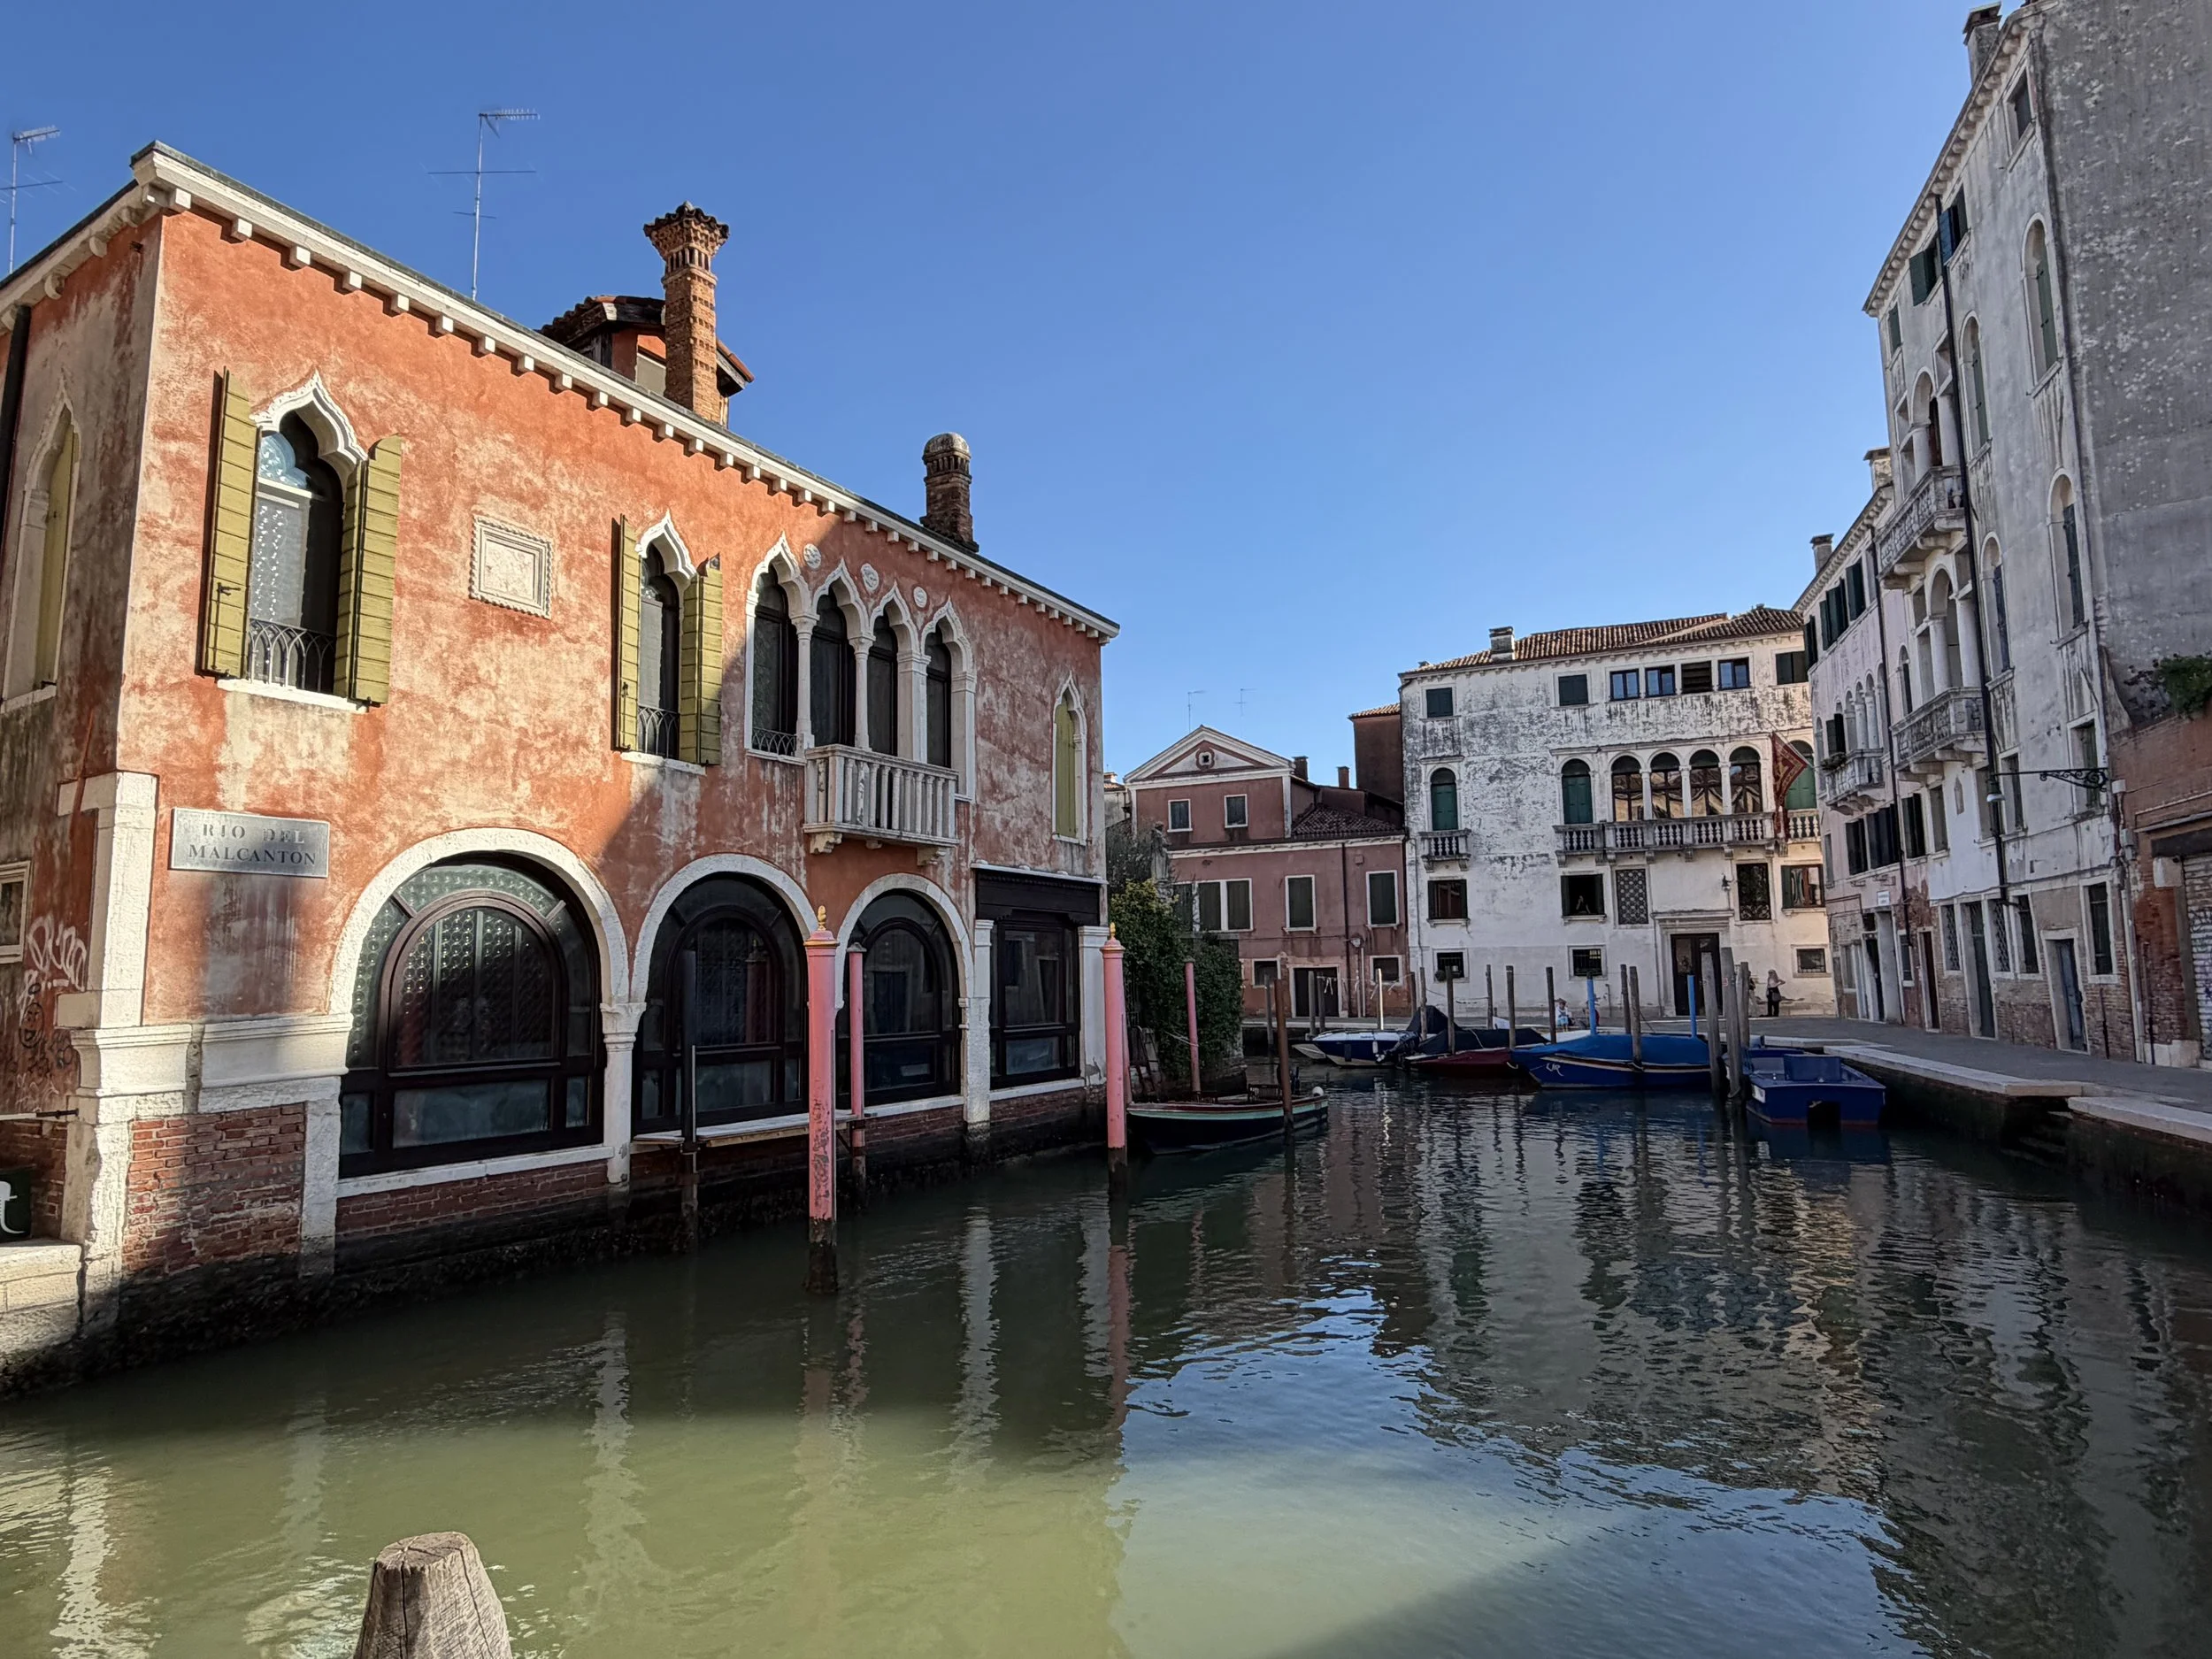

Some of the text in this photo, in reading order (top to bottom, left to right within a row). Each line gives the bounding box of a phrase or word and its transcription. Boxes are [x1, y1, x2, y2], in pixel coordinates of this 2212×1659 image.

[203, 824, 305, 844] RIO DEL
[188, 844, 315, 865] MALCANTON
